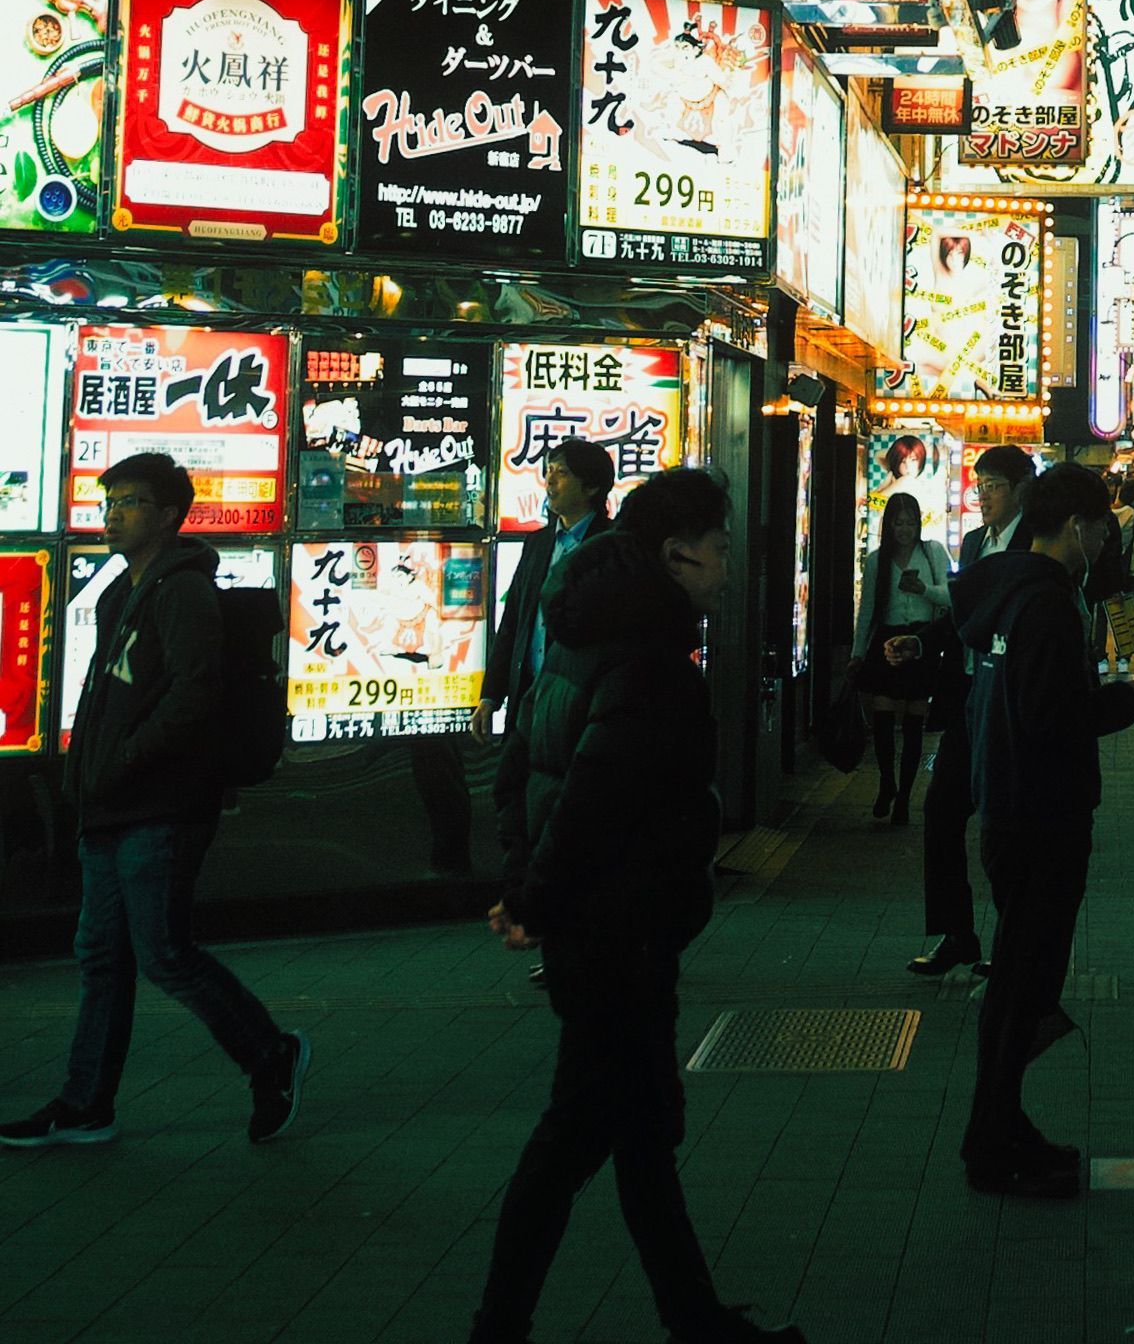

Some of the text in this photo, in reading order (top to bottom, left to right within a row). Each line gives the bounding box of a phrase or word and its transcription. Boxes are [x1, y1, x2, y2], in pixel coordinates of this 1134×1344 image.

[474, 23, 495, 47] &
[179, 48, 290, 92] 火鳳祥
[441, 45, 557, 82] ダーツバー
[587, 3, 640, 137] 九十九
[899, 90, 957, 106] 24時間
[896, 105, 960, 123] 年中無休
[968, 130, 1078, 159] マドンナ
[486, 149, 521, 169] 新宿店
[377, 181, 542, 215] http://www.hide-out.jp/
[395, 206, 418, 229] TEL
[620, 242, 666, 261] 九十九
[525, 349, 623, 392] 低料金
[442, 416, 469, 433] Bar
[77, 440, 103, 462] 2F
[304, 547, 352, 658] 九十九
[327, 718, 375, 740] 九十九
